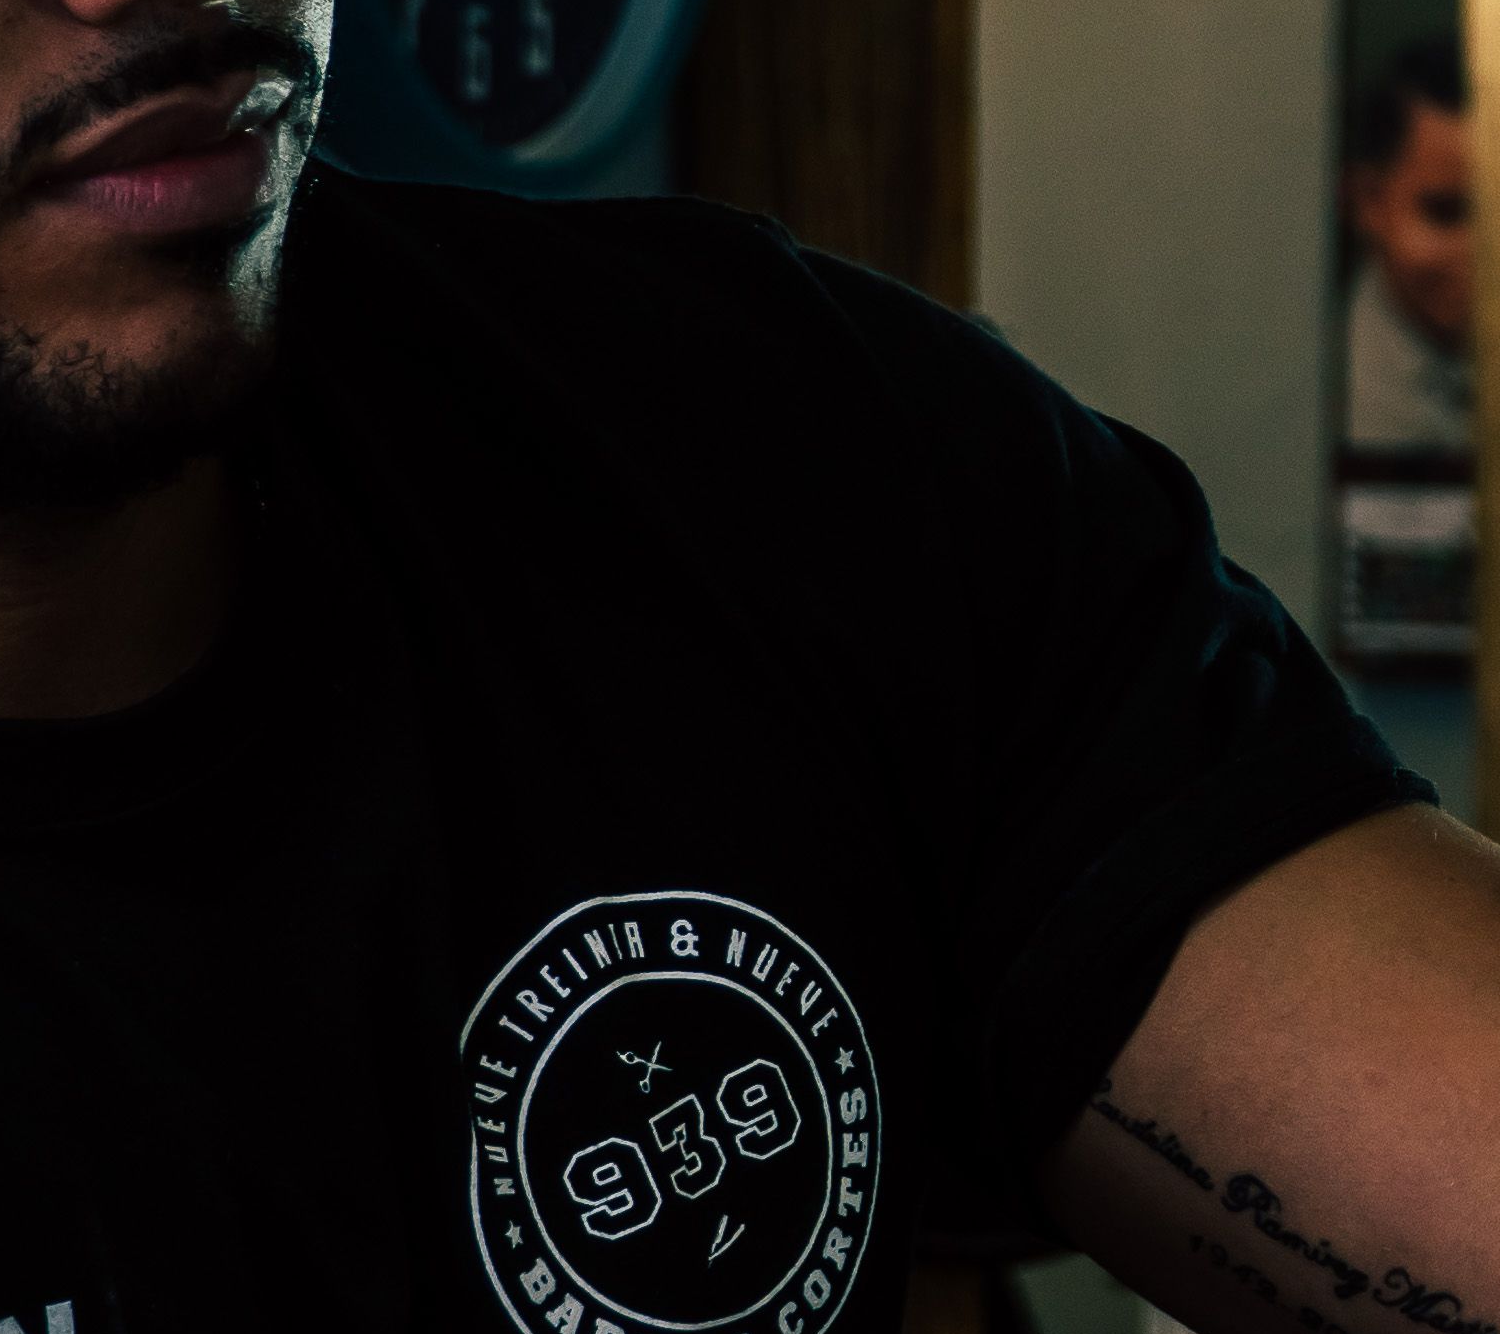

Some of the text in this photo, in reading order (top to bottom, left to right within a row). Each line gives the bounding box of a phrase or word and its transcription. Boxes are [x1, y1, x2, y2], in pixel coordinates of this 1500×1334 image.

[474, 1054, 518, 1195] NUEVE
[670, 919, 700, 958] &
[725, 928, 838, 1037] NUEVE
[563, 1058, 802, 1240] 939
